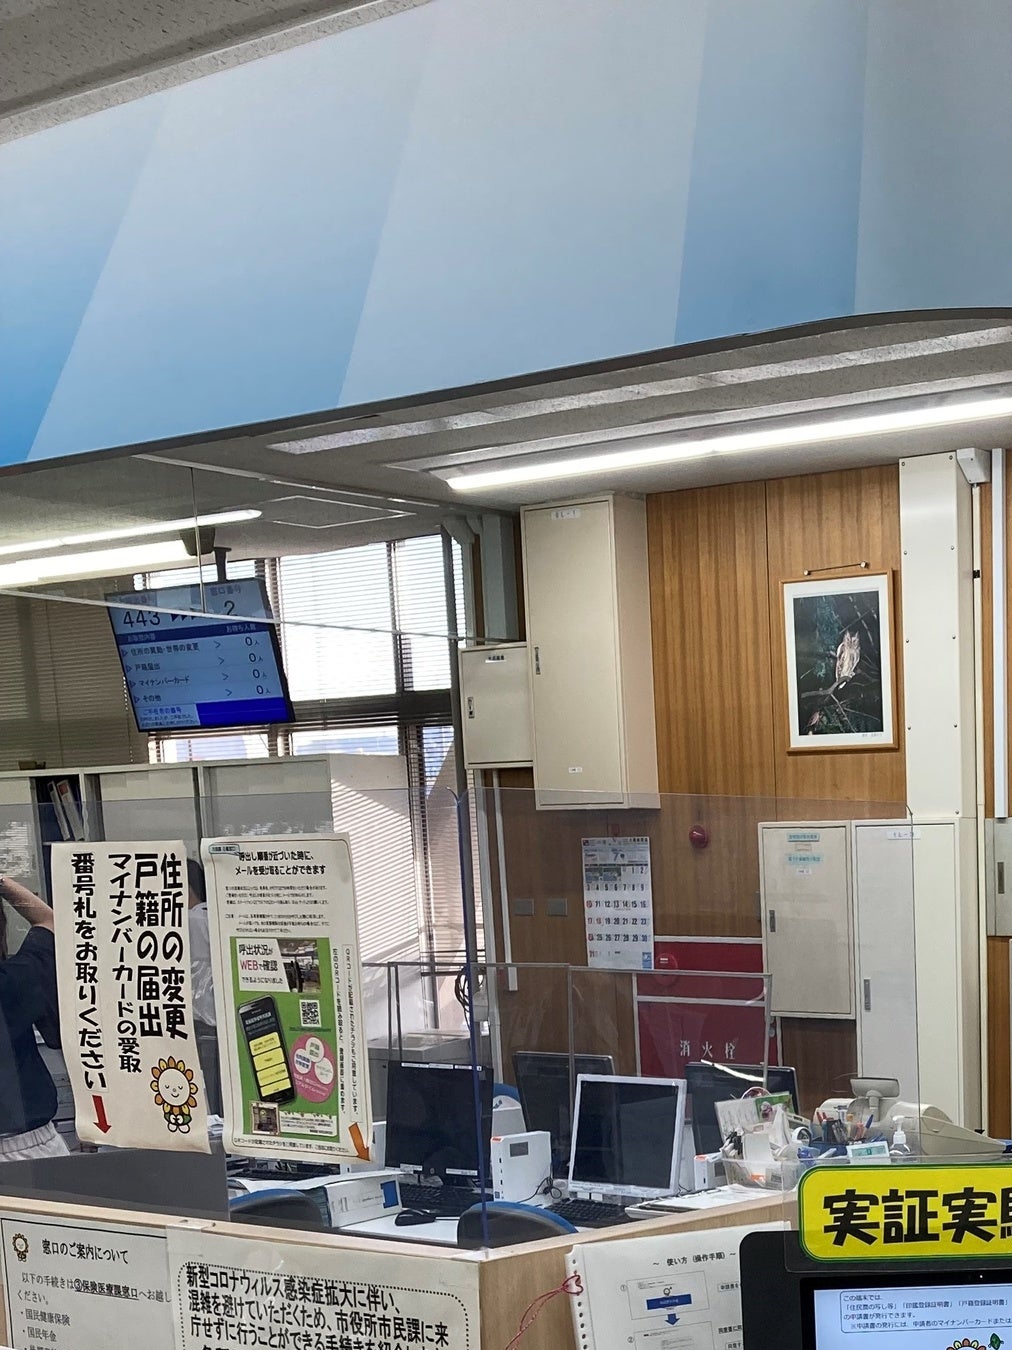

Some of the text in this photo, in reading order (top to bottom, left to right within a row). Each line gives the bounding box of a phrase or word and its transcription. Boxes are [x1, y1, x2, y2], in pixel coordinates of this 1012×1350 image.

[123, 609, 161, 628] 443
[223, 600, 237, 616] 2
[235, 865, 326, 876] メールを受け取ることができます
[134, 853, 163, 1038] 戸籍の届出
[160, 852, 188, 1040] 住所の変更
[71, 852, 107, 1089] 番号札をお取りください
[108, 853, 142, 1073] マイナンバーカードの受取
[240, 960, 279, 971] WEBで確認
[680, 1040, 736, 1060] 消火栓
[42, 1238, 129, 1265] 窓口のご案内について
[17, 1290, 49, 1305] ください。
[186, 1264, 401, 1314] 新型コロナウィルス感染症拡大に伴い、
[188, 1289, 450, 1347] 混雑を避けていただくため、市役所市民課に来
